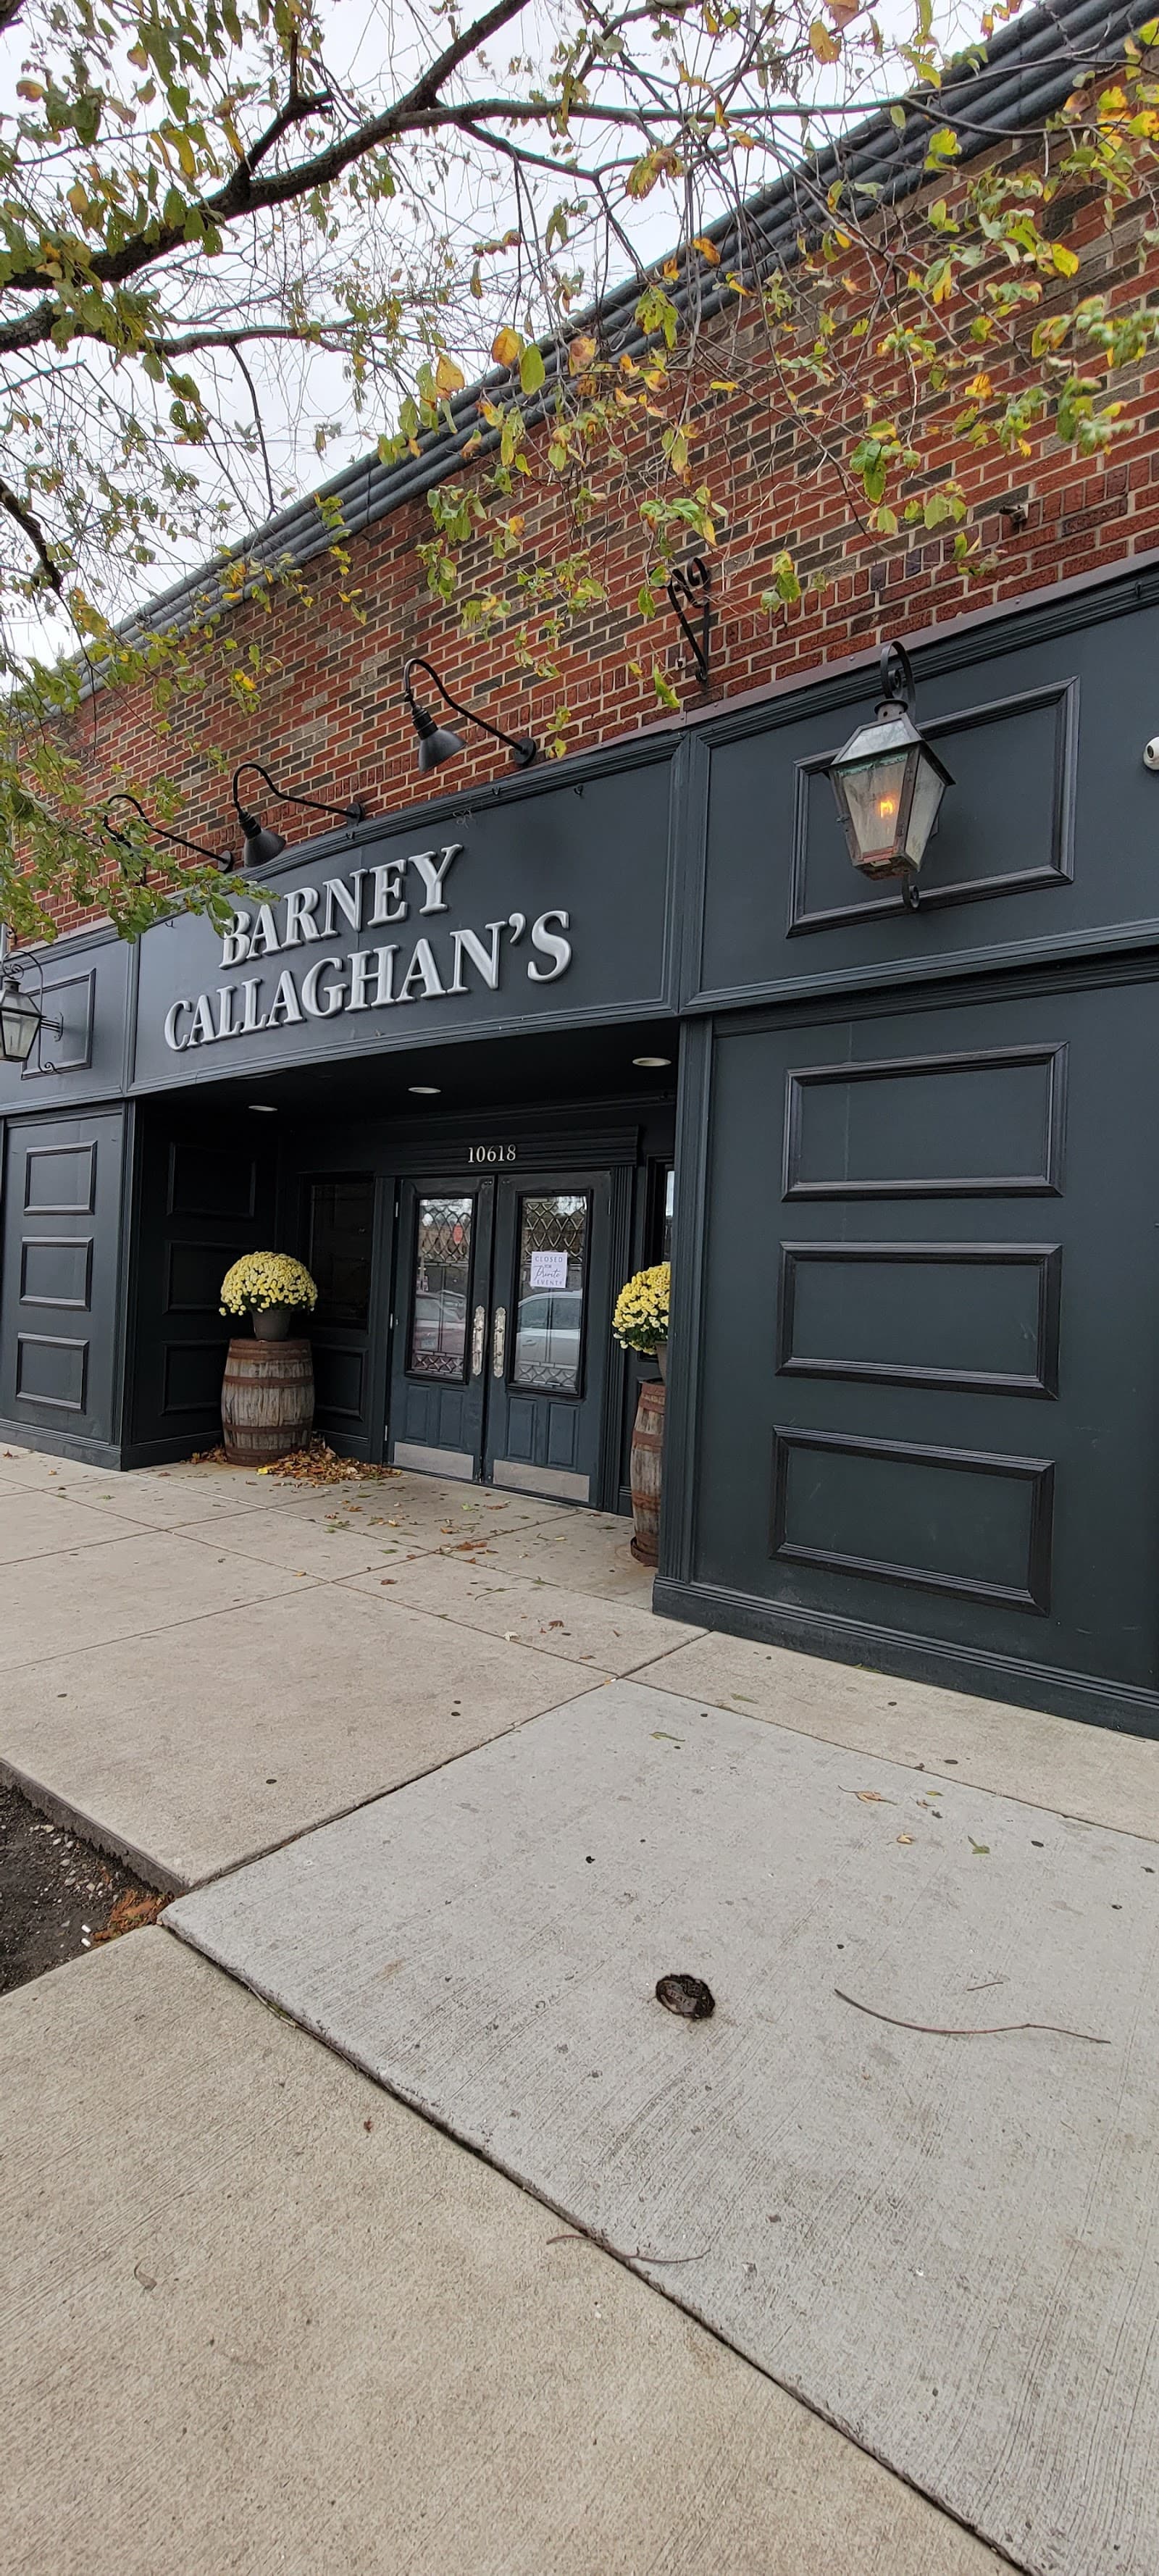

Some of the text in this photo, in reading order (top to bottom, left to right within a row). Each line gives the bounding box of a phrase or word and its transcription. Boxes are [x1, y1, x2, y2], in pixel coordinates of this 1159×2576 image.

[219, 843, 464, 971] BARNEY
[164, 910, 573, 1053] CALLAGHAN'S
[467, 1144, 516, 1163] 10618
